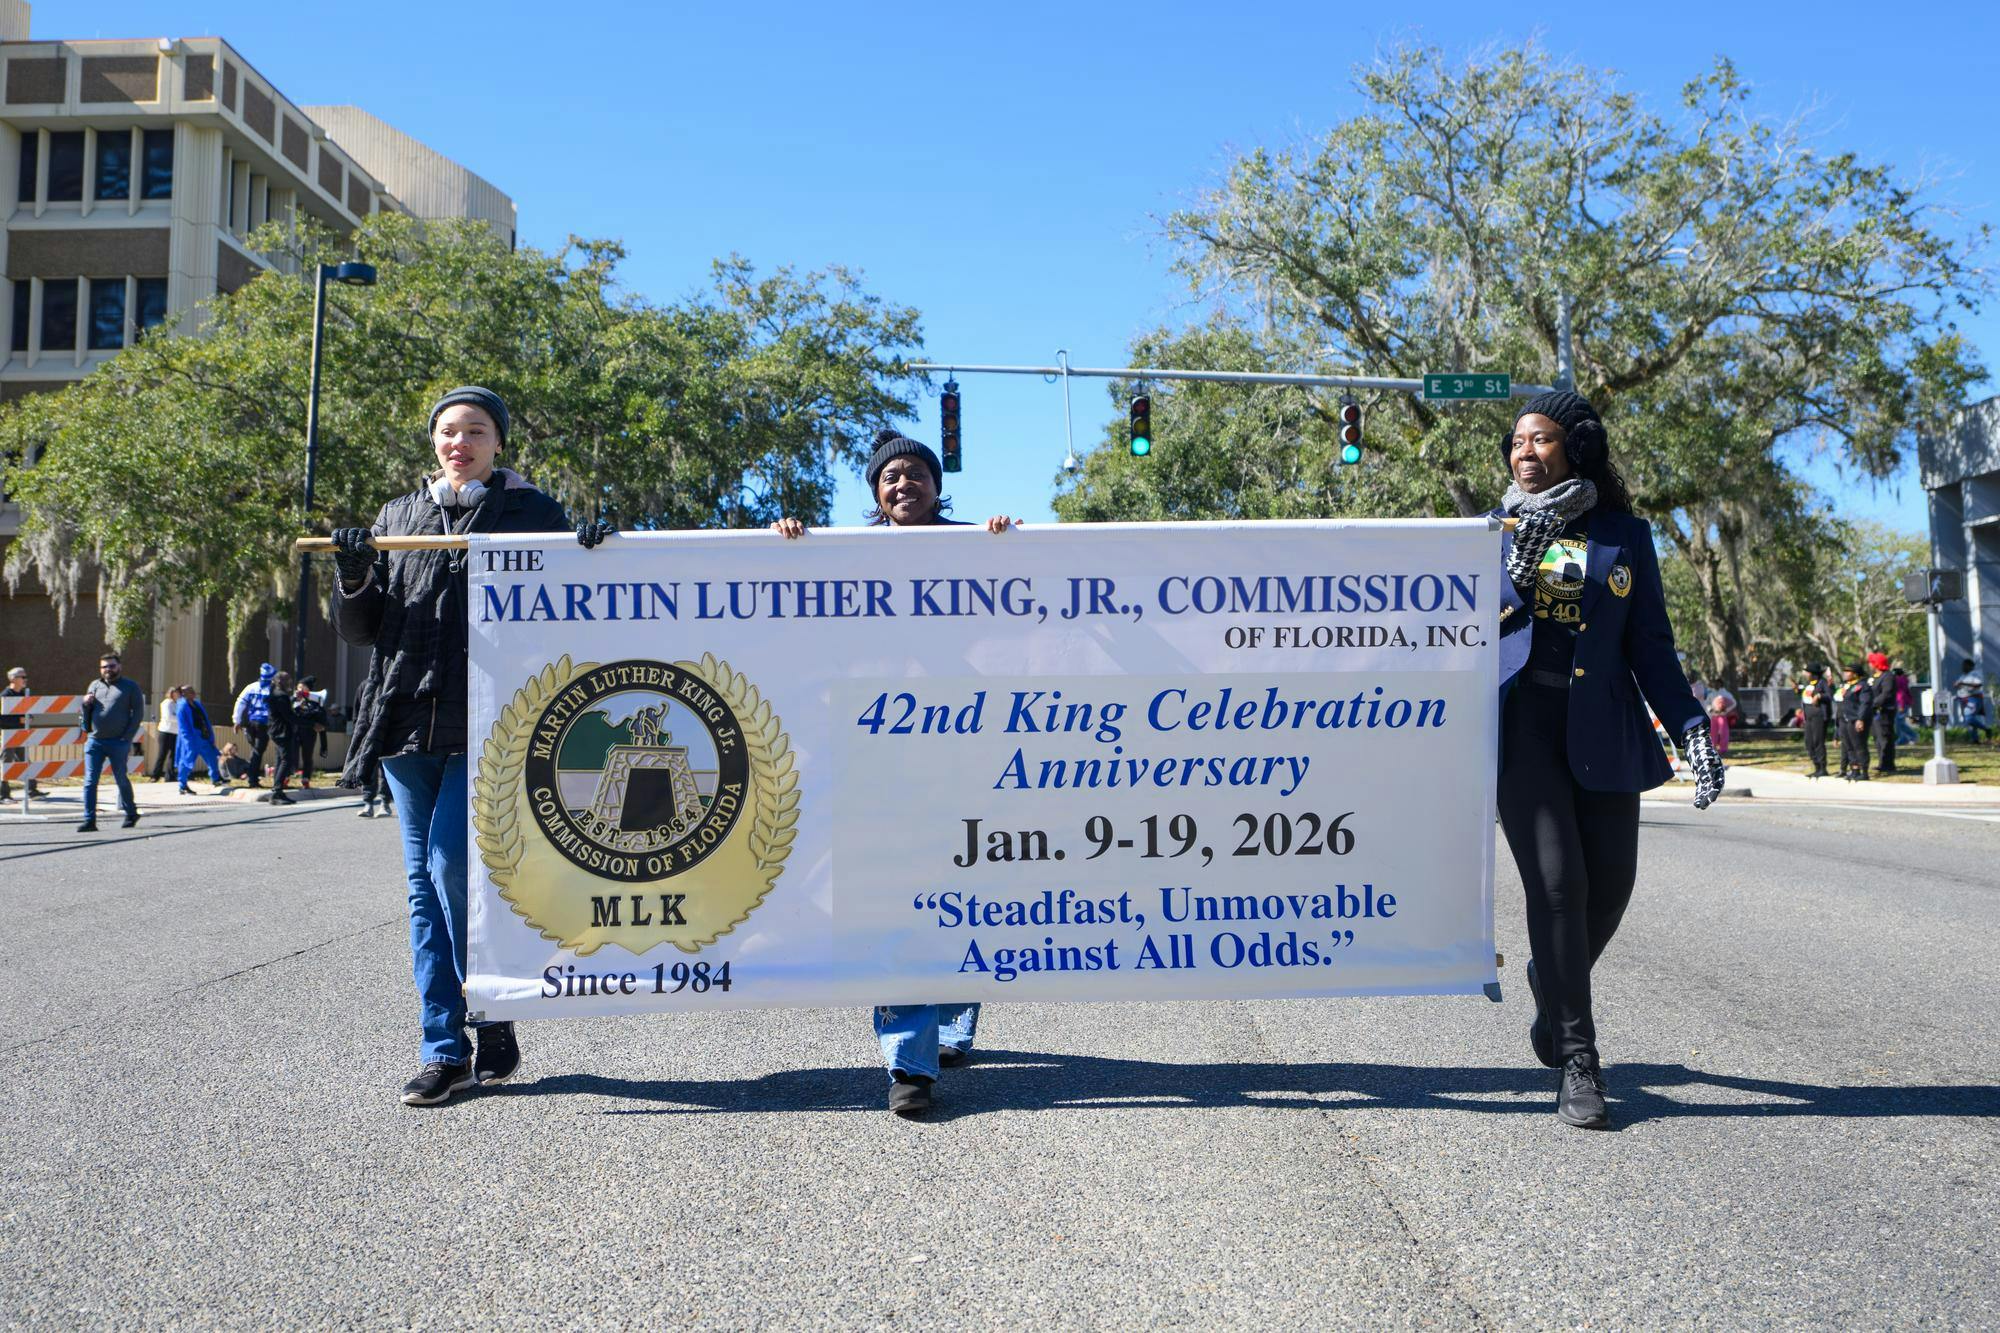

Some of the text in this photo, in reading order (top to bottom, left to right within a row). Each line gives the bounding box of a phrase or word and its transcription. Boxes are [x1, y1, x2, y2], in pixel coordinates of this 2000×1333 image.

[1431, 379, 1442, 394] E
[1484, 379, 1507, 394] St.
[481, 549, 544, 572] THE
[481, 574, 1480, 624] MARTIN LUTHER KING, JR., COMMISSION
[1552, 603, 1581, 619] 40
[1224, 624, 1487, 652] OF FLORIDA, INC.
[533, 666, 736, 760] MARTIN LUTHER KING Jr.
[857, 686, 1447, 743] 42nd King Celebration
[992, 745, 1310, 797] Anniversary
[533, 782, 742, 876] COMMISSION OF FLORIDA
[578, 808, 699, 849] EST. 1984
[953, 811, 1356, 868] Jan. 9-19, 2026
[590, 893, 687, 928] MLK
[913, 884, 1397, 931] “Steadfast, Unmovable
[957, 929, 1355, 982] Against All Odds.”
[541, 960, 732, 999] Since 1984
